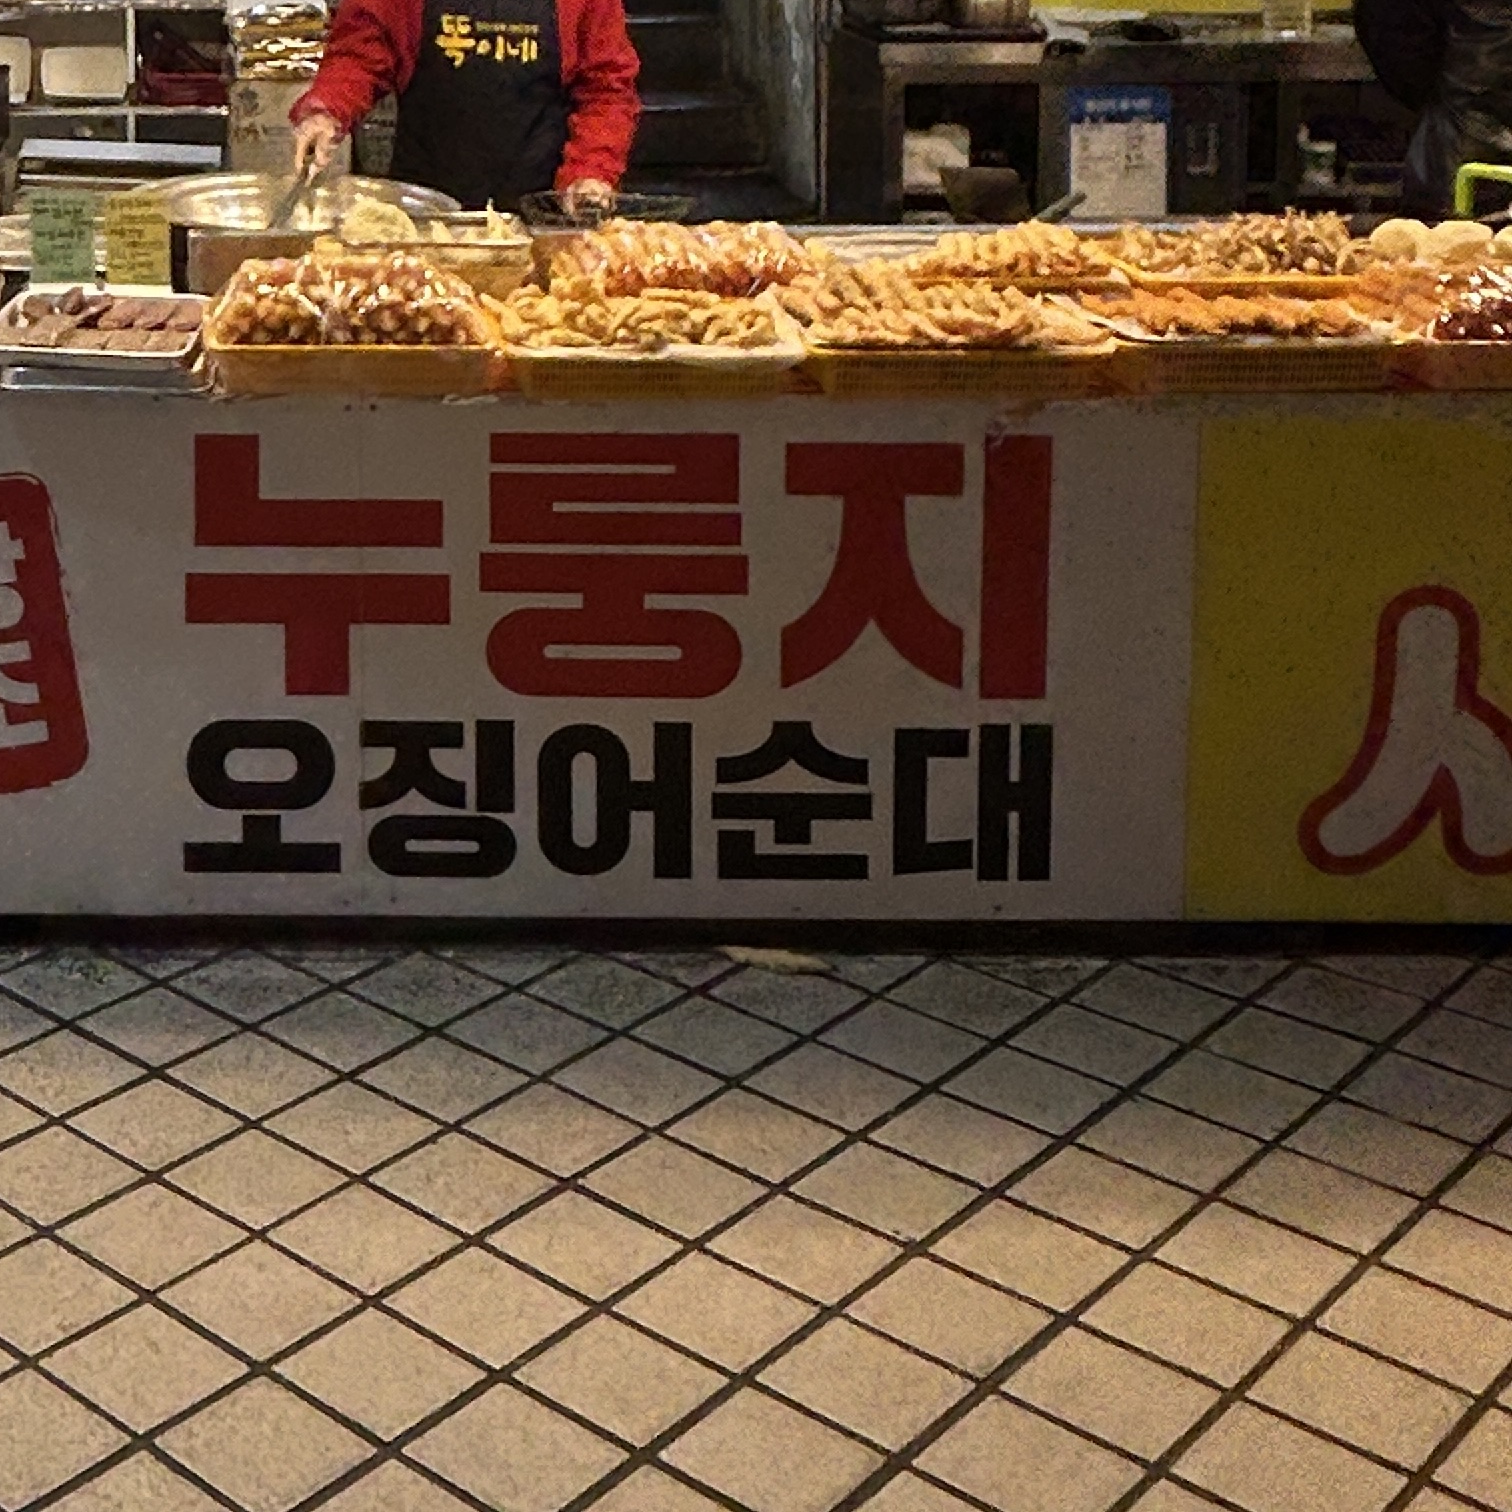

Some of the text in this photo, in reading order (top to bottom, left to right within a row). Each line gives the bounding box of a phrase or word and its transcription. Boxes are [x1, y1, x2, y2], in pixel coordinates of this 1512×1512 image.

[435, 13, 539, 68] 똑이네
[184, 431, 1054, 700] 누룽지
[183, 717, 1055, 881] 오징어순대
